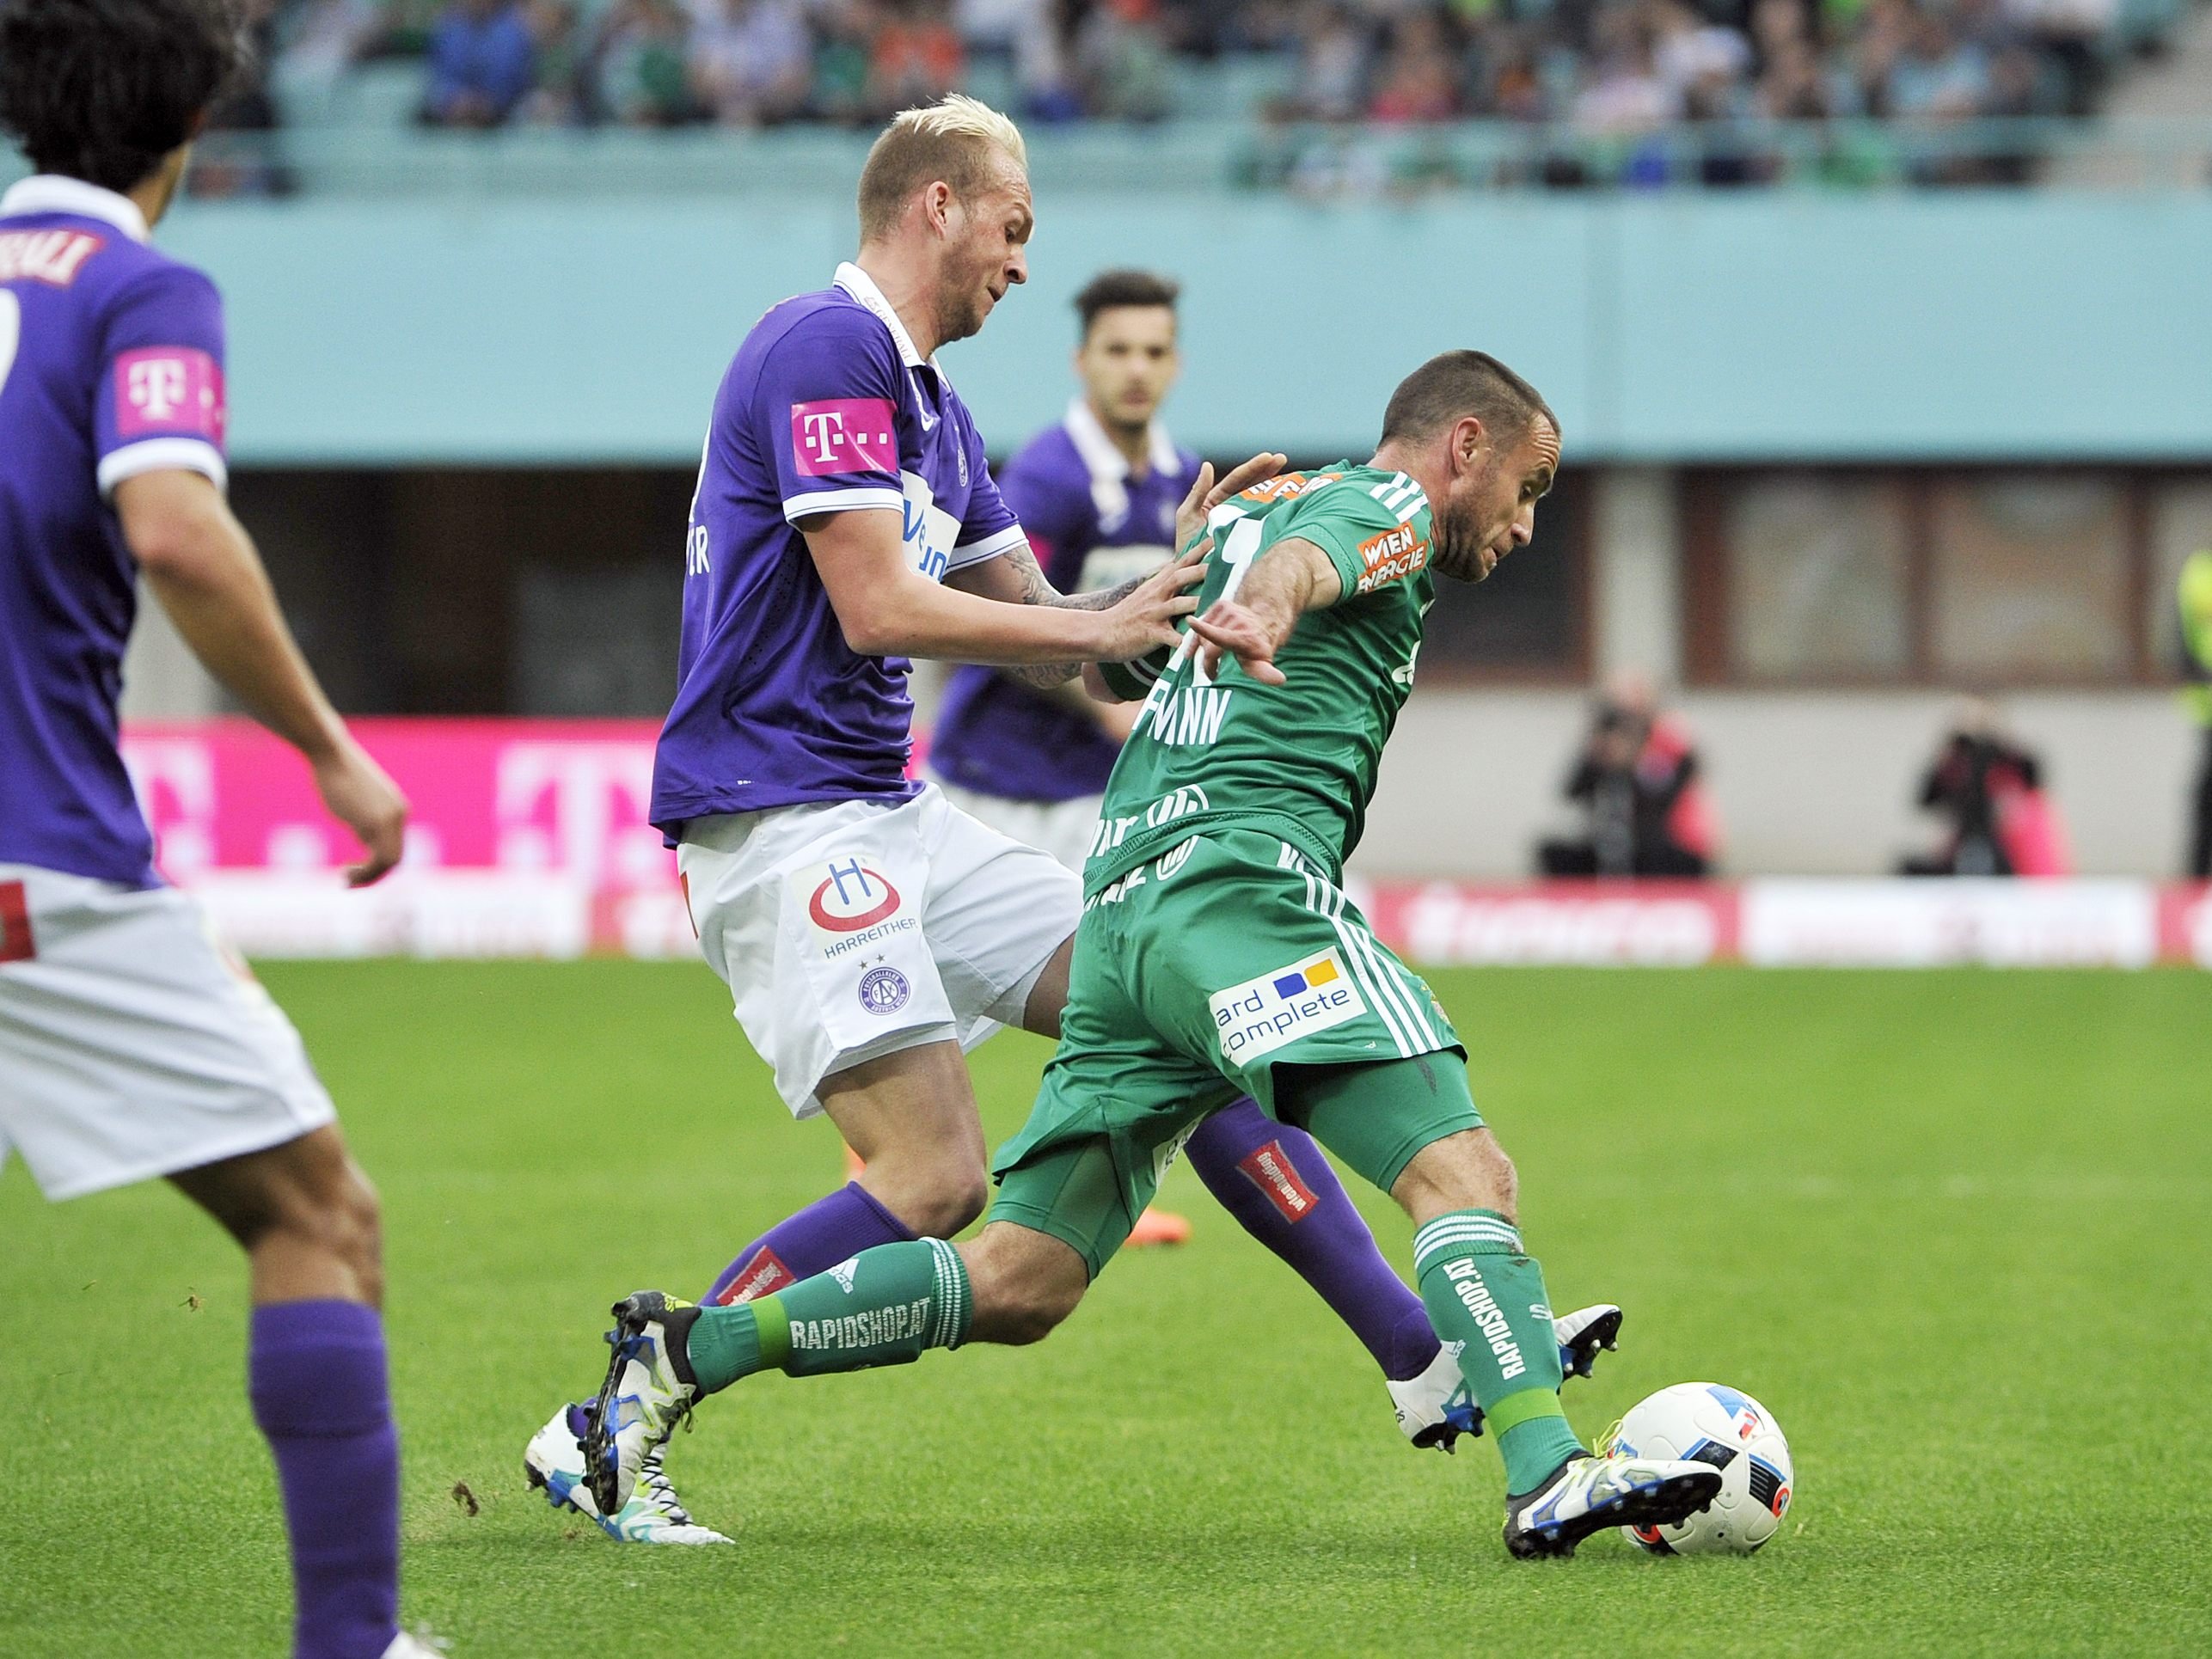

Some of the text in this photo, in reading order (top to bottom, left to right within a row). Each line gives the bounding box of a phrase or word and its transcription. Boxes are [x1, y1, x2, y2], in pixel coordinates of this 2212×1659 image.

[1363, 525, 1414, 567] WIEN
[824, 918, 918, 959] HARREITHER
[1216, 989, 1260, 1027] ard
[789, 1296, 931, 1350] RAPIDSHOP.AT
[1442, 1258, 1527, 1380] RAPIDSHOP.AT
